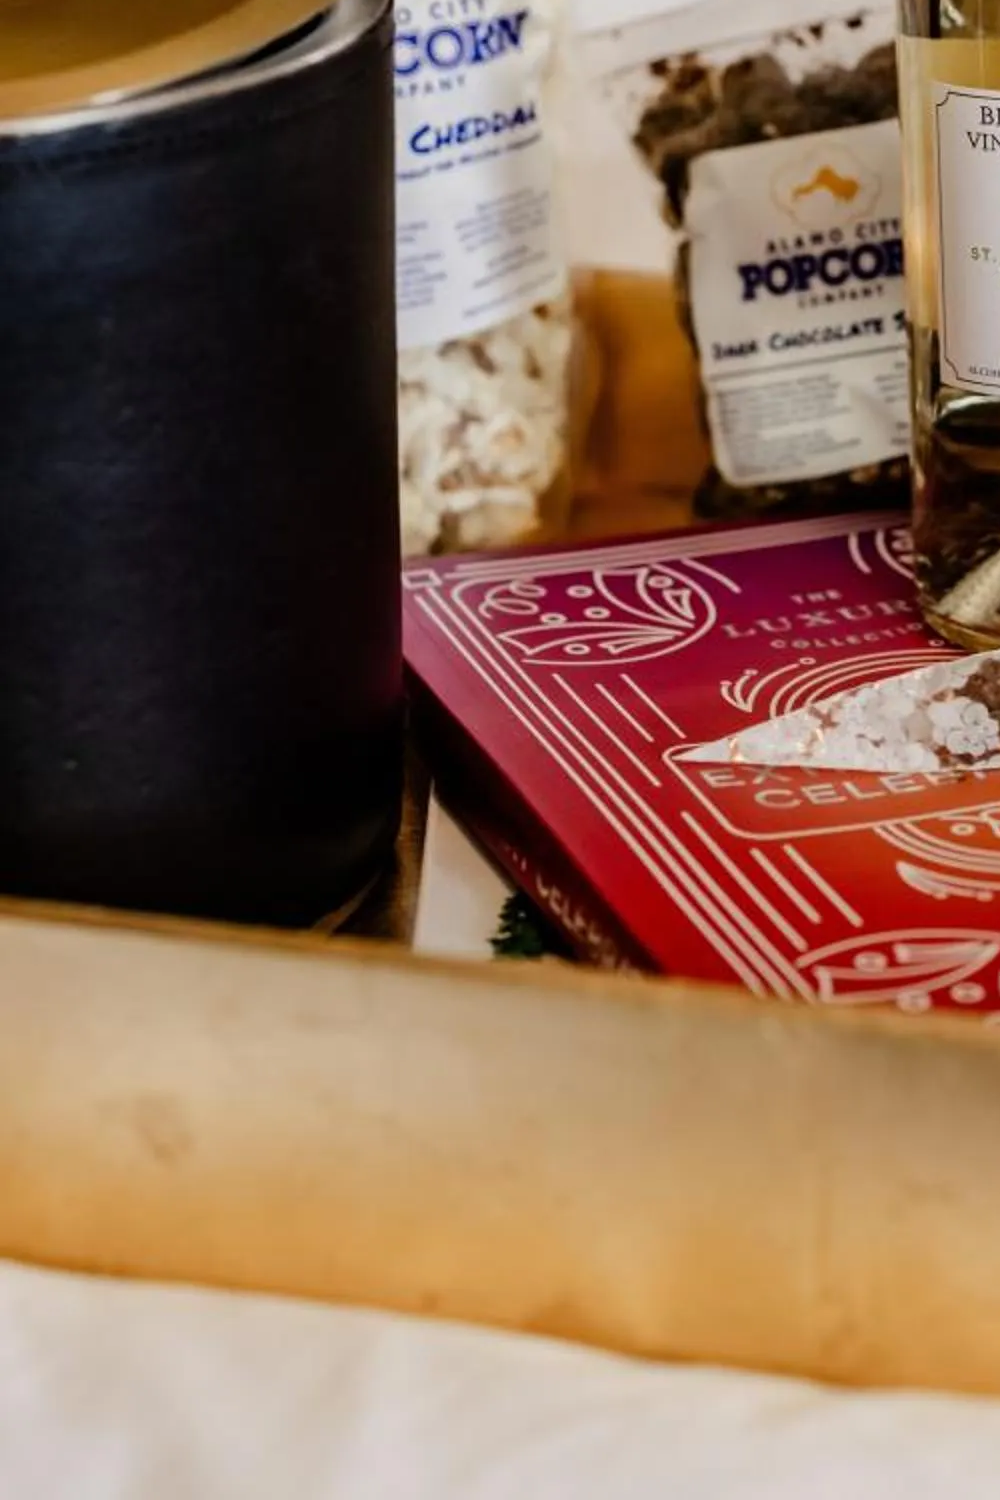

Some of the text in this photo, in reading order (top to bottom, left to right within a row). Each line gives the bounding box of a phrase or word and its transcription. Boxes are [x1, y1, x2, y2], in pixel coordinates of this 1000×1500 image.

[394, 9, 529, 75] CORN
[767, 228, 844, 253] ALAMO
[970, 247, 996, 263] ST.
[738, 238, 904, 301] POPCOR
[721, 600, 913, 639] LUXUR
[769, 622, 923, 649] COLLECTIO
